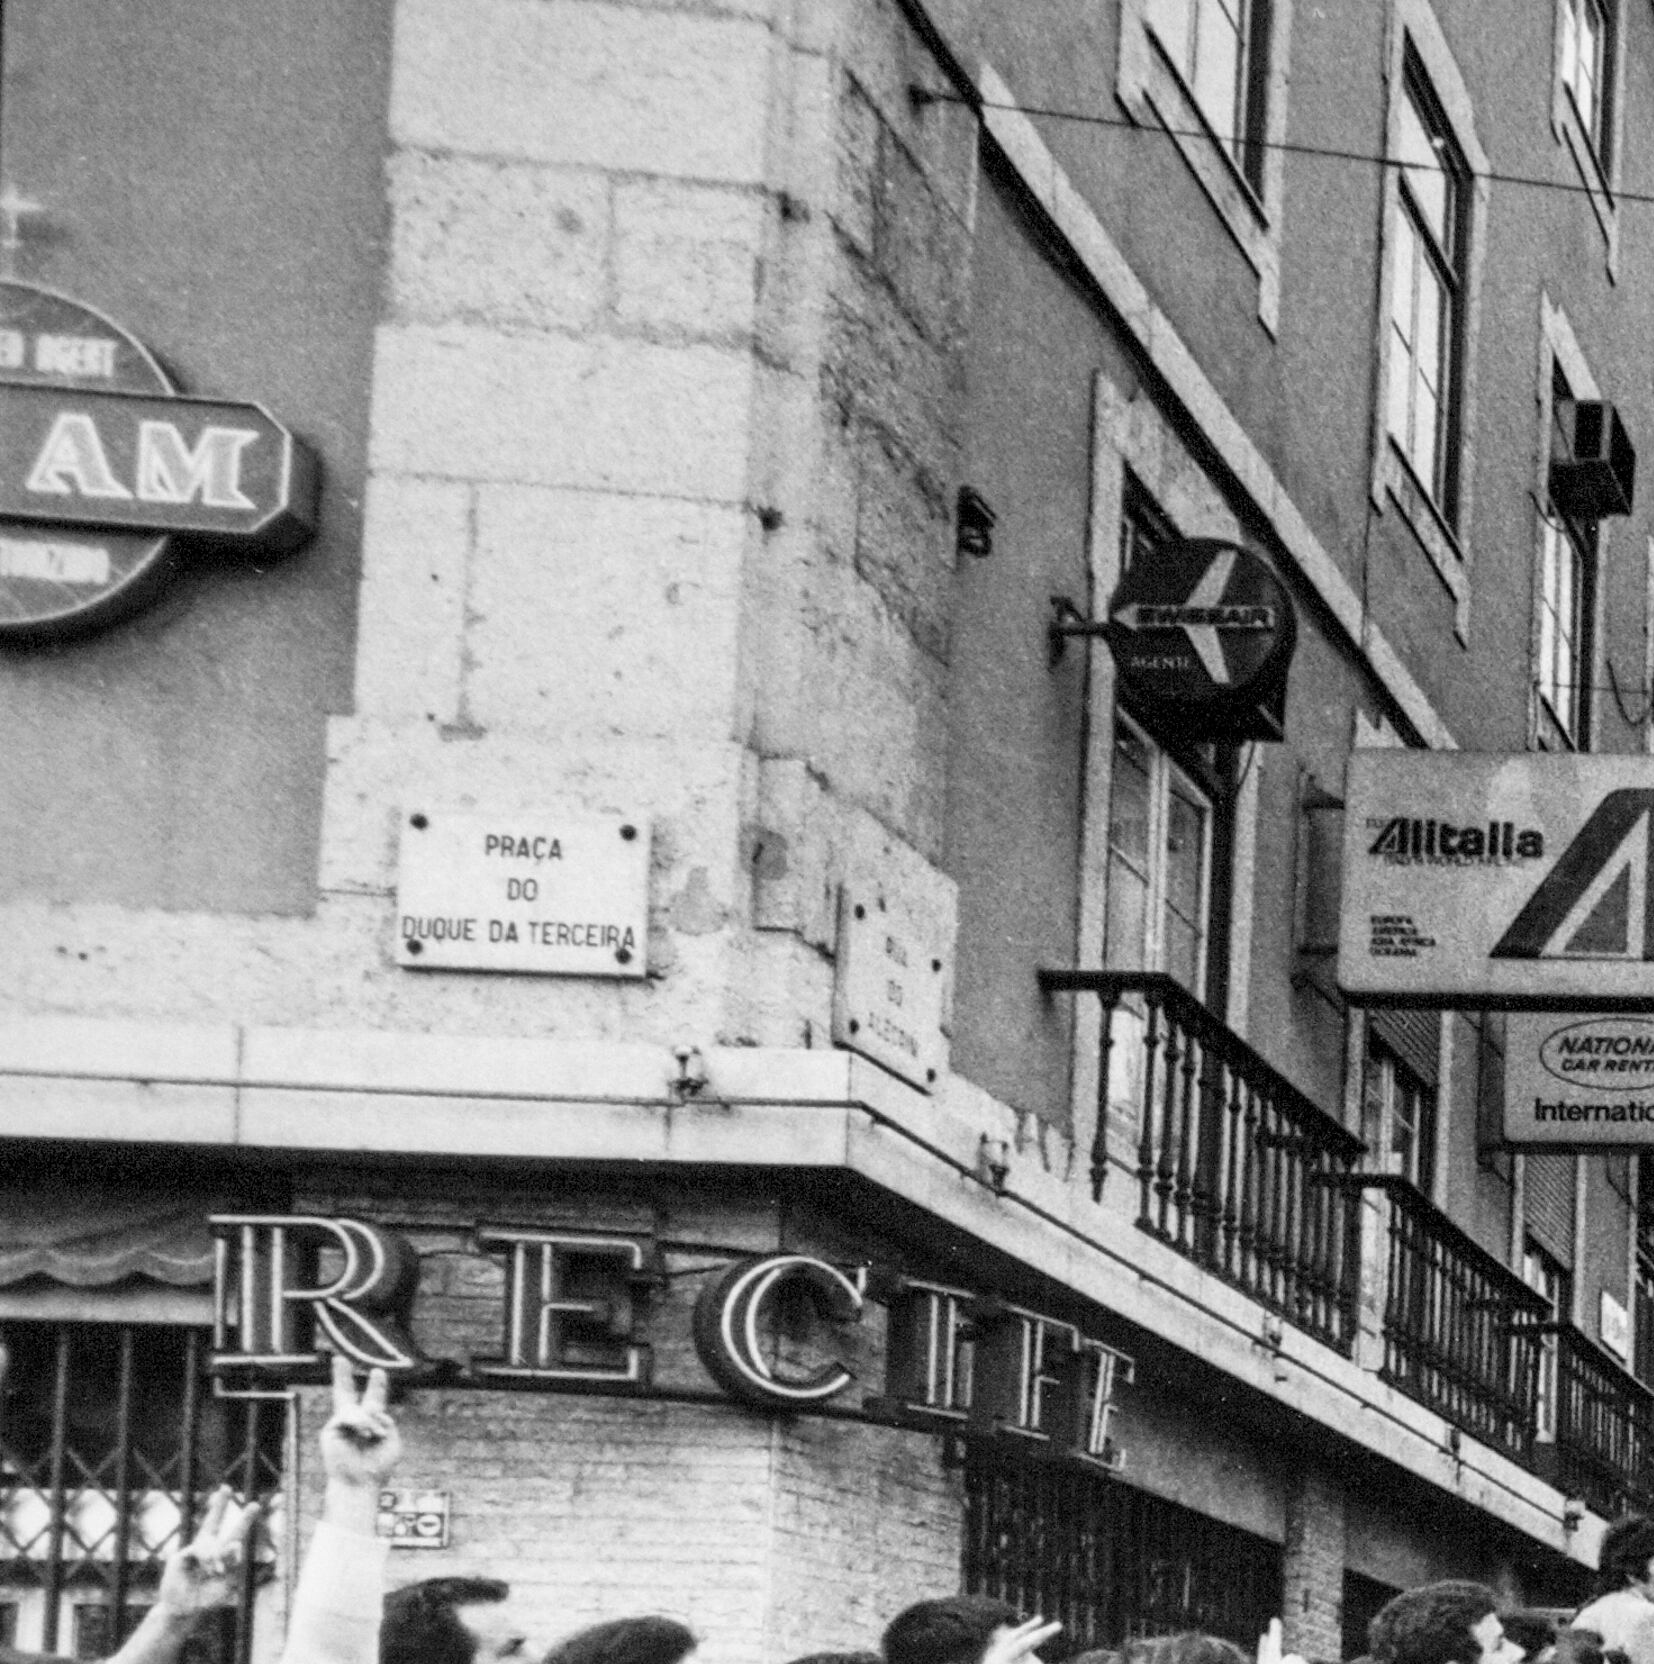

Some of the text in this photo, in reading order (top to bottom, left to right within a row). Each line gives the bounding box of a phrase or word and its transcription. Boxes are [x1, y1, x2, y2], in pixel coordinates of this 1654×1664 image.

[25, 413, 260, 510] AM
[484, 833, 563, 864] PRAÇA
[1368, 817, 1544, 859] Alitalia
[506, 876, 538, 902] DO
[401, 915, 636, 950] DUQUE DA TERCEIRA
[1560, 1059, 1600, 1072] CAR
[206, 1212, 1138, 1474] RECIFE
